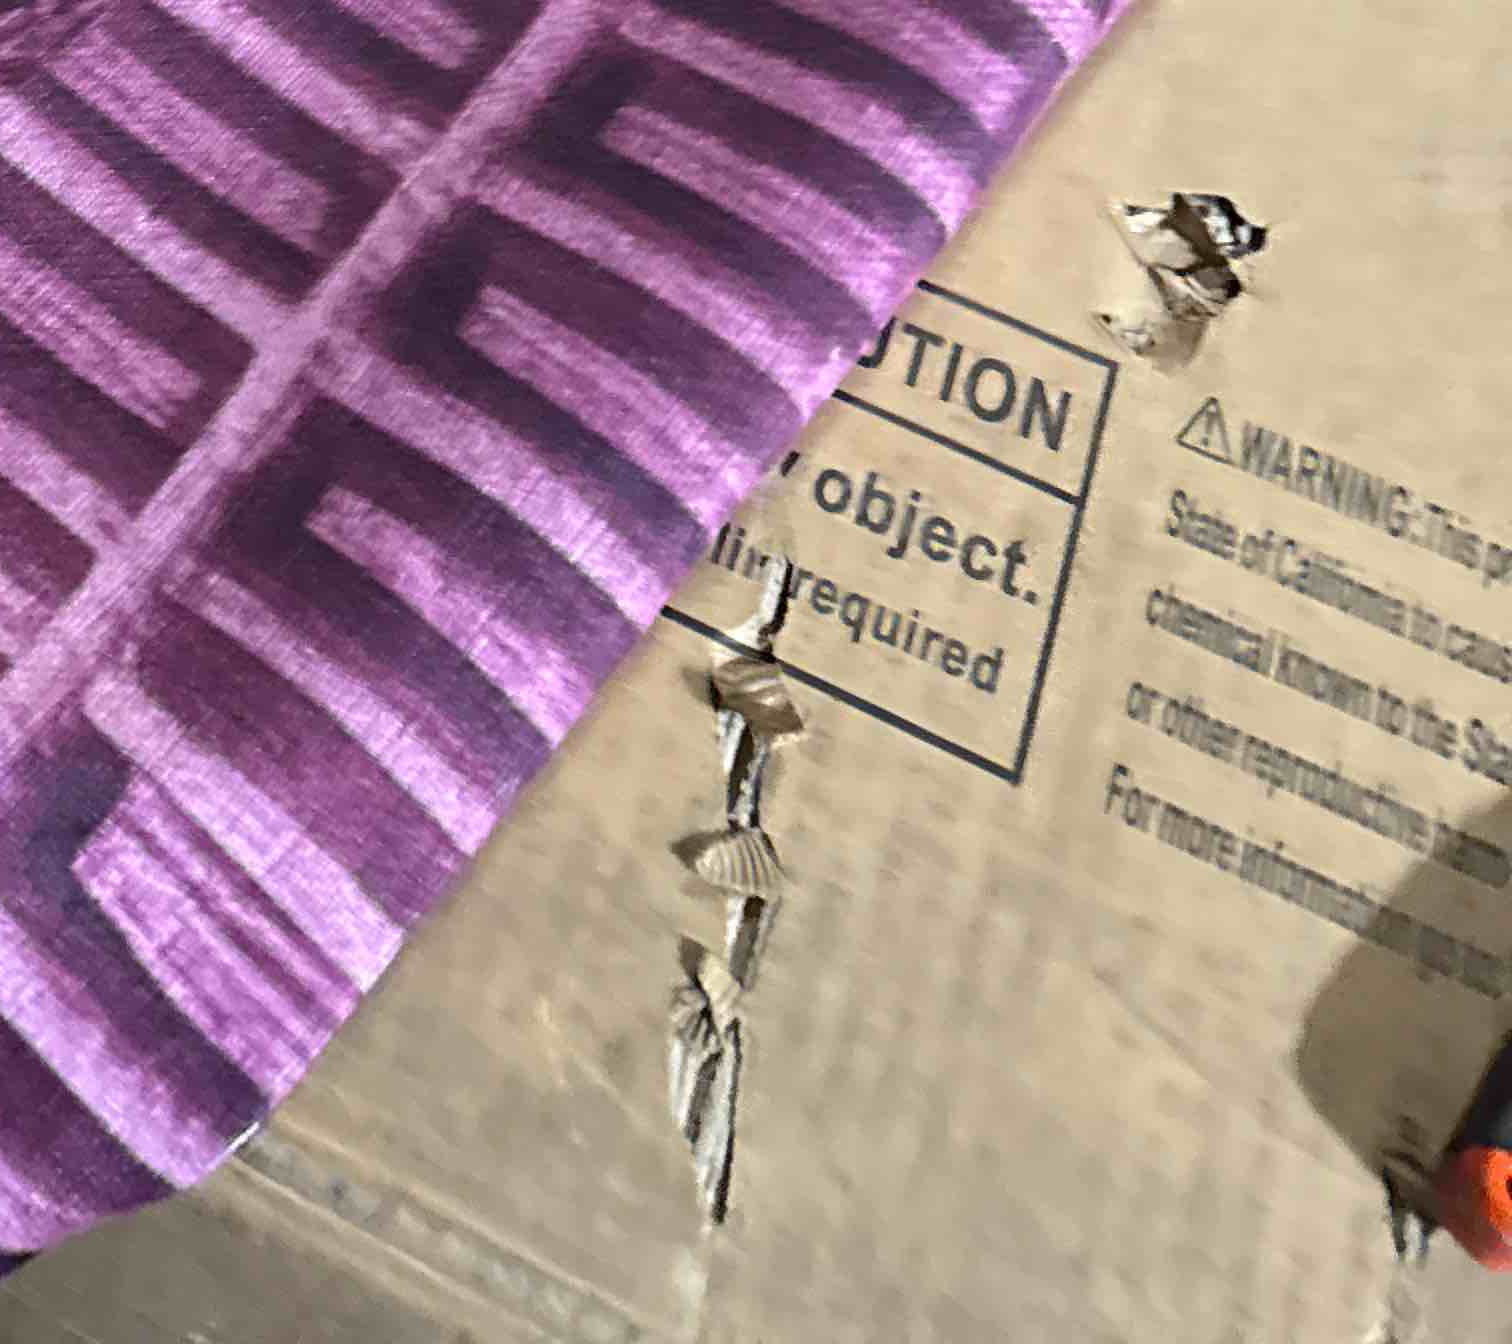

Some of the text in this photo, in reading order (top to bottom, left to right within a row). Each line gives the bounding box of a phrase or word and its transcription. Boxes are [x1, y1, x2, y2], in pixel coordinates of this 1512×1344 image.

[813, 468, 1039, 606] object.
[788, 568, 1005, 695] required
[1104, 762, 1160, 835] For
